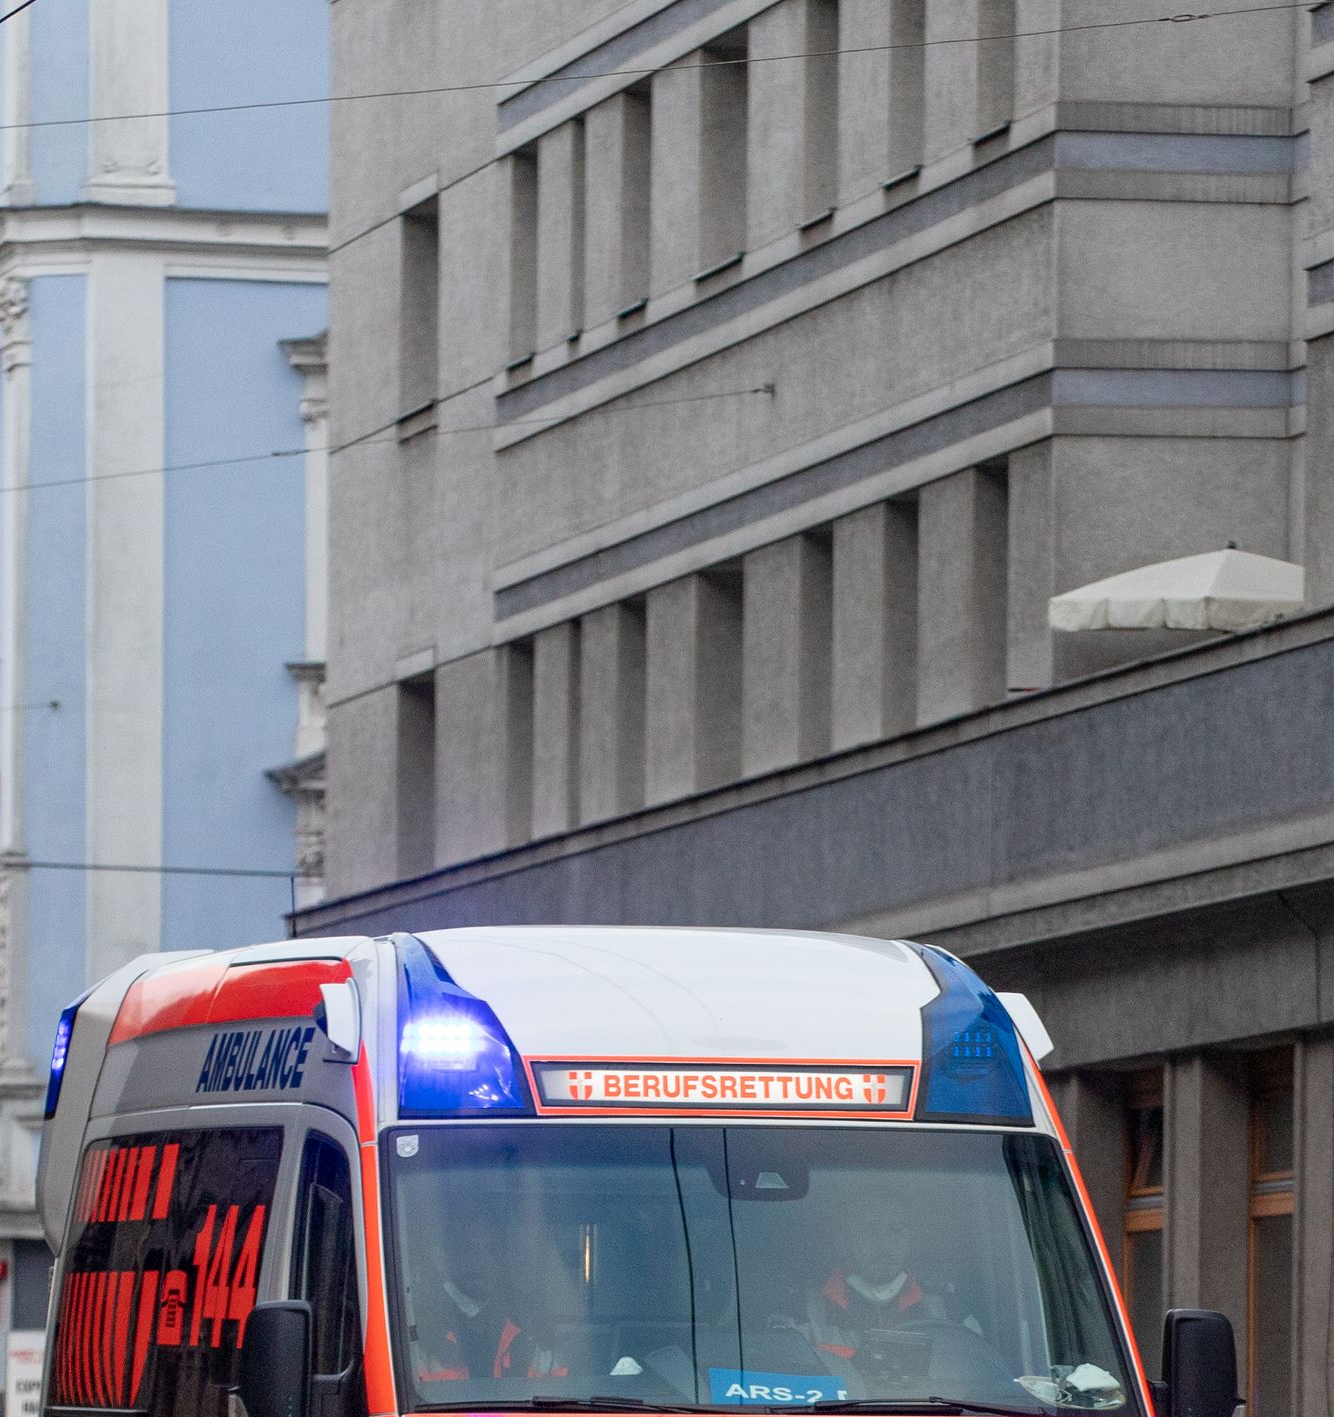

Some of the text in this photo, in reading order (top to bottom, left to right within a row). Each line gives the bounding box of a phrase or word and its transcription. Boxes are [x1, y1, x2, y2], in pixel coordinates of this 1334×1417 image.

[196, 1027, 315, 1093] AMBULANCE
[603, 1073, 854, 1101] BERUFSRETTUNG
[188, 1204, 266, 1350] 144
[725, 1383, 823, 1403] ARS-2
